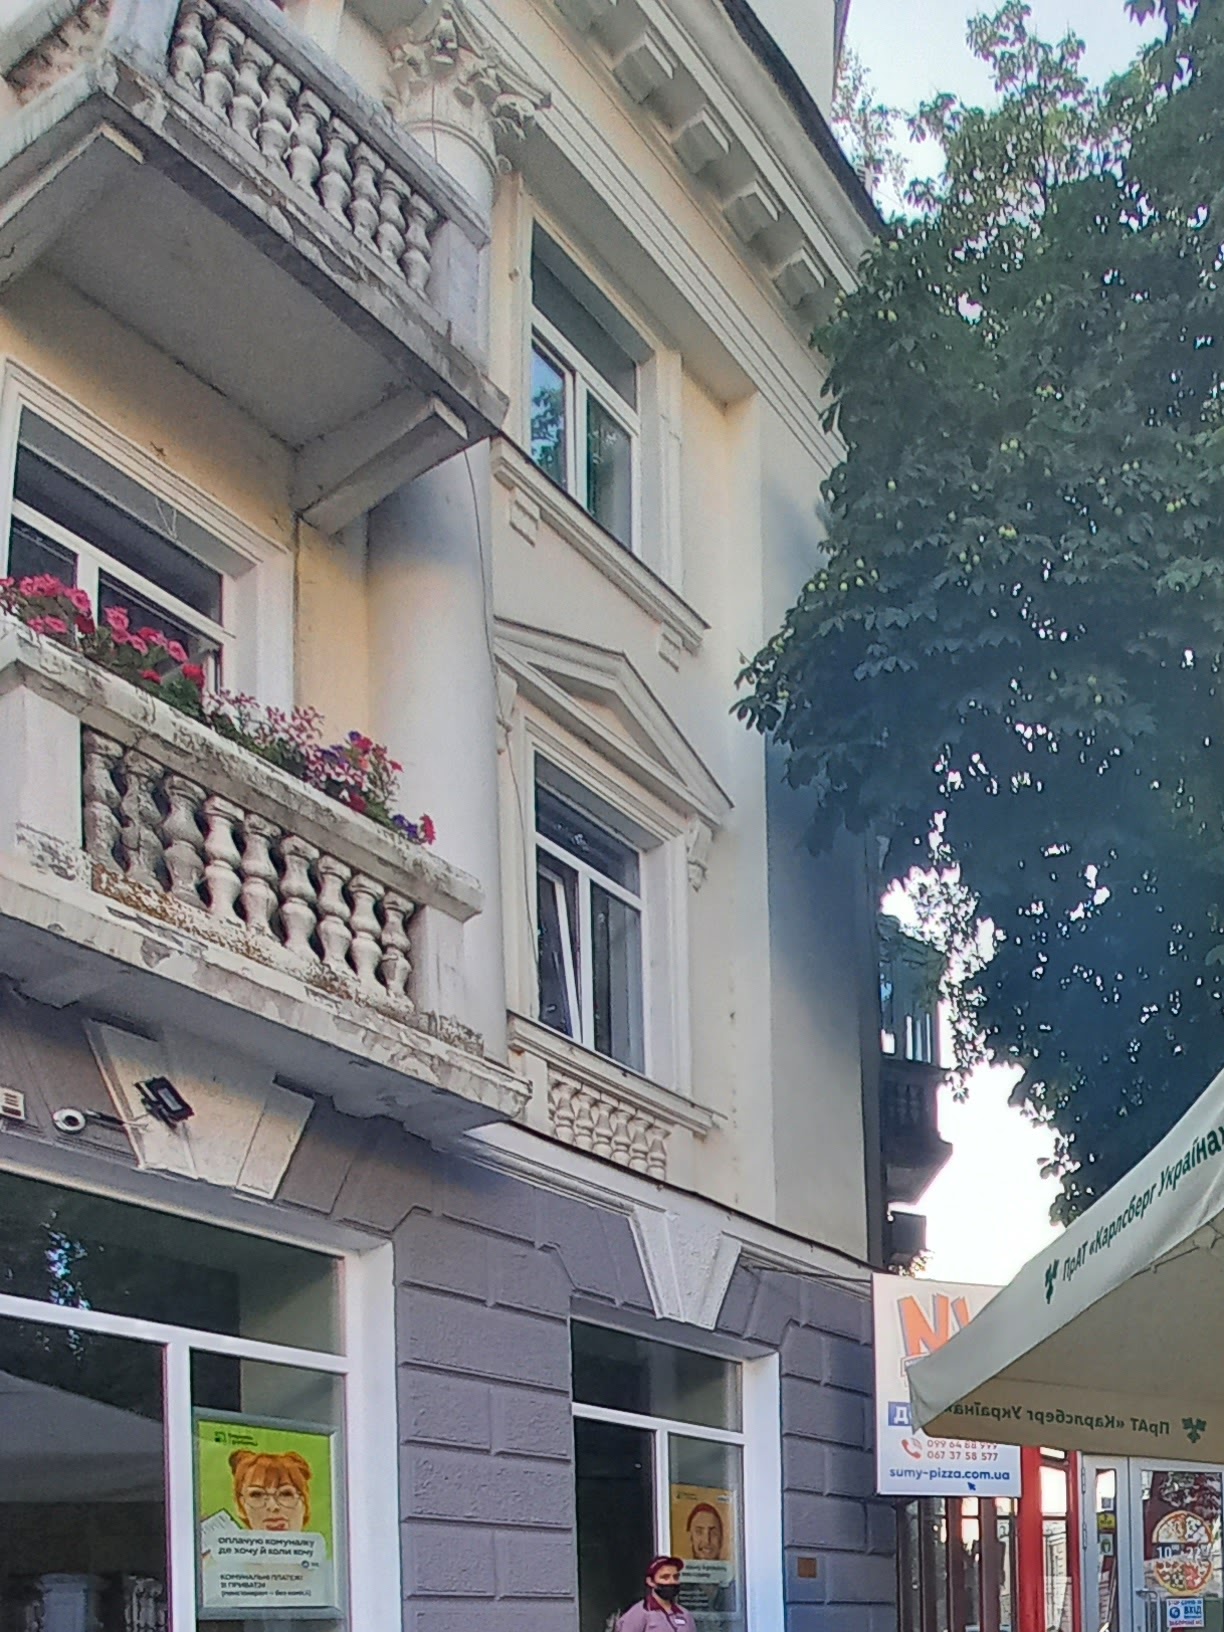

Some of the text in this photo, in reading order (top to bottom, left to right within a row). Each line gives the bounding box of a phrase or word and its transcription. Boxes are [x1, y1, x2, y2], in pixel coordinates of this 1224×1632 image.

[1062, 1241, 1087, 1281] ПрАТ
[1089, 1183, 1157, 1256] «Карлсберг
[927, 1450, 999, 1461] 067 37 58 577
[889, 1467, 1010, 1481] sumy-pizza.com.ua
